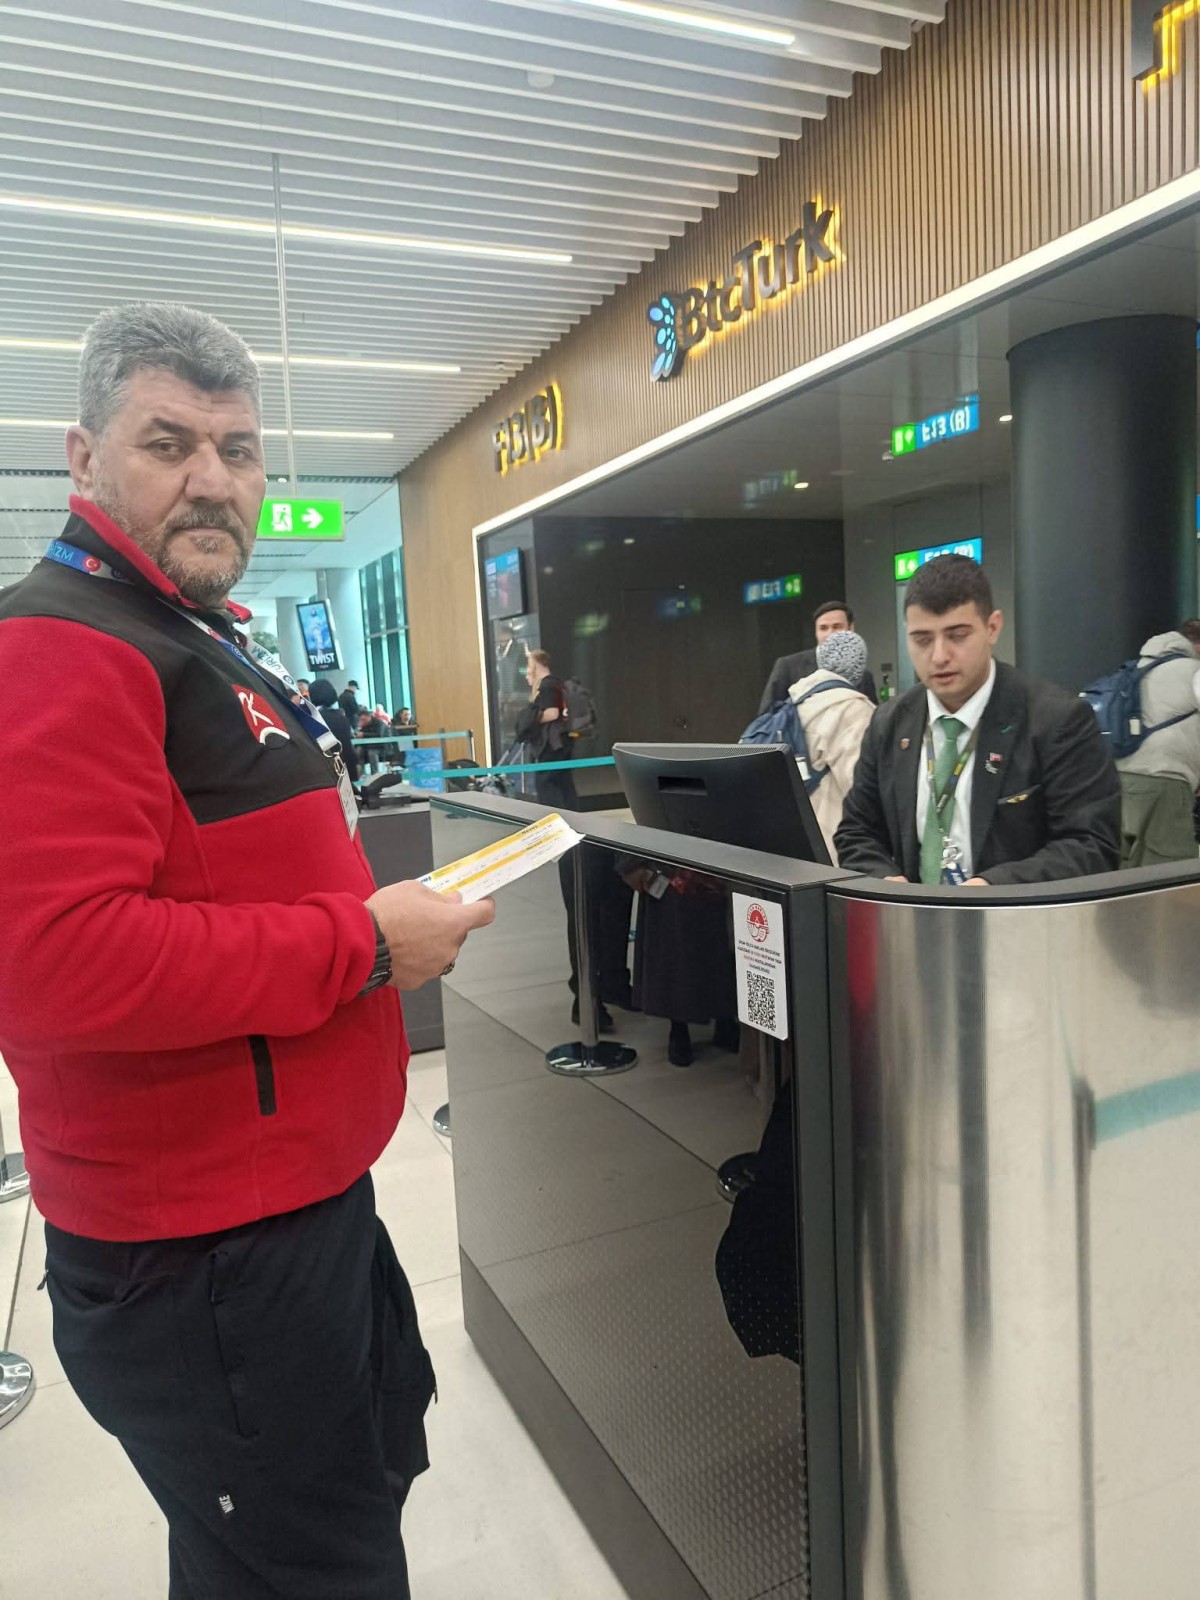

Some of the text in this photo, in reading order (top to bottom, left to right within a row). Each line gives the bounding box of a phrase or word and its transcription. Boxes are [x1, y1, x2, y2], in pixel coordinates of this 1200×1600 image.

[679, 200, 835, 351] BtcTurk
[309, 652, 335, 665] TWIST
[219, 1494, 235, 1514] NIKE
